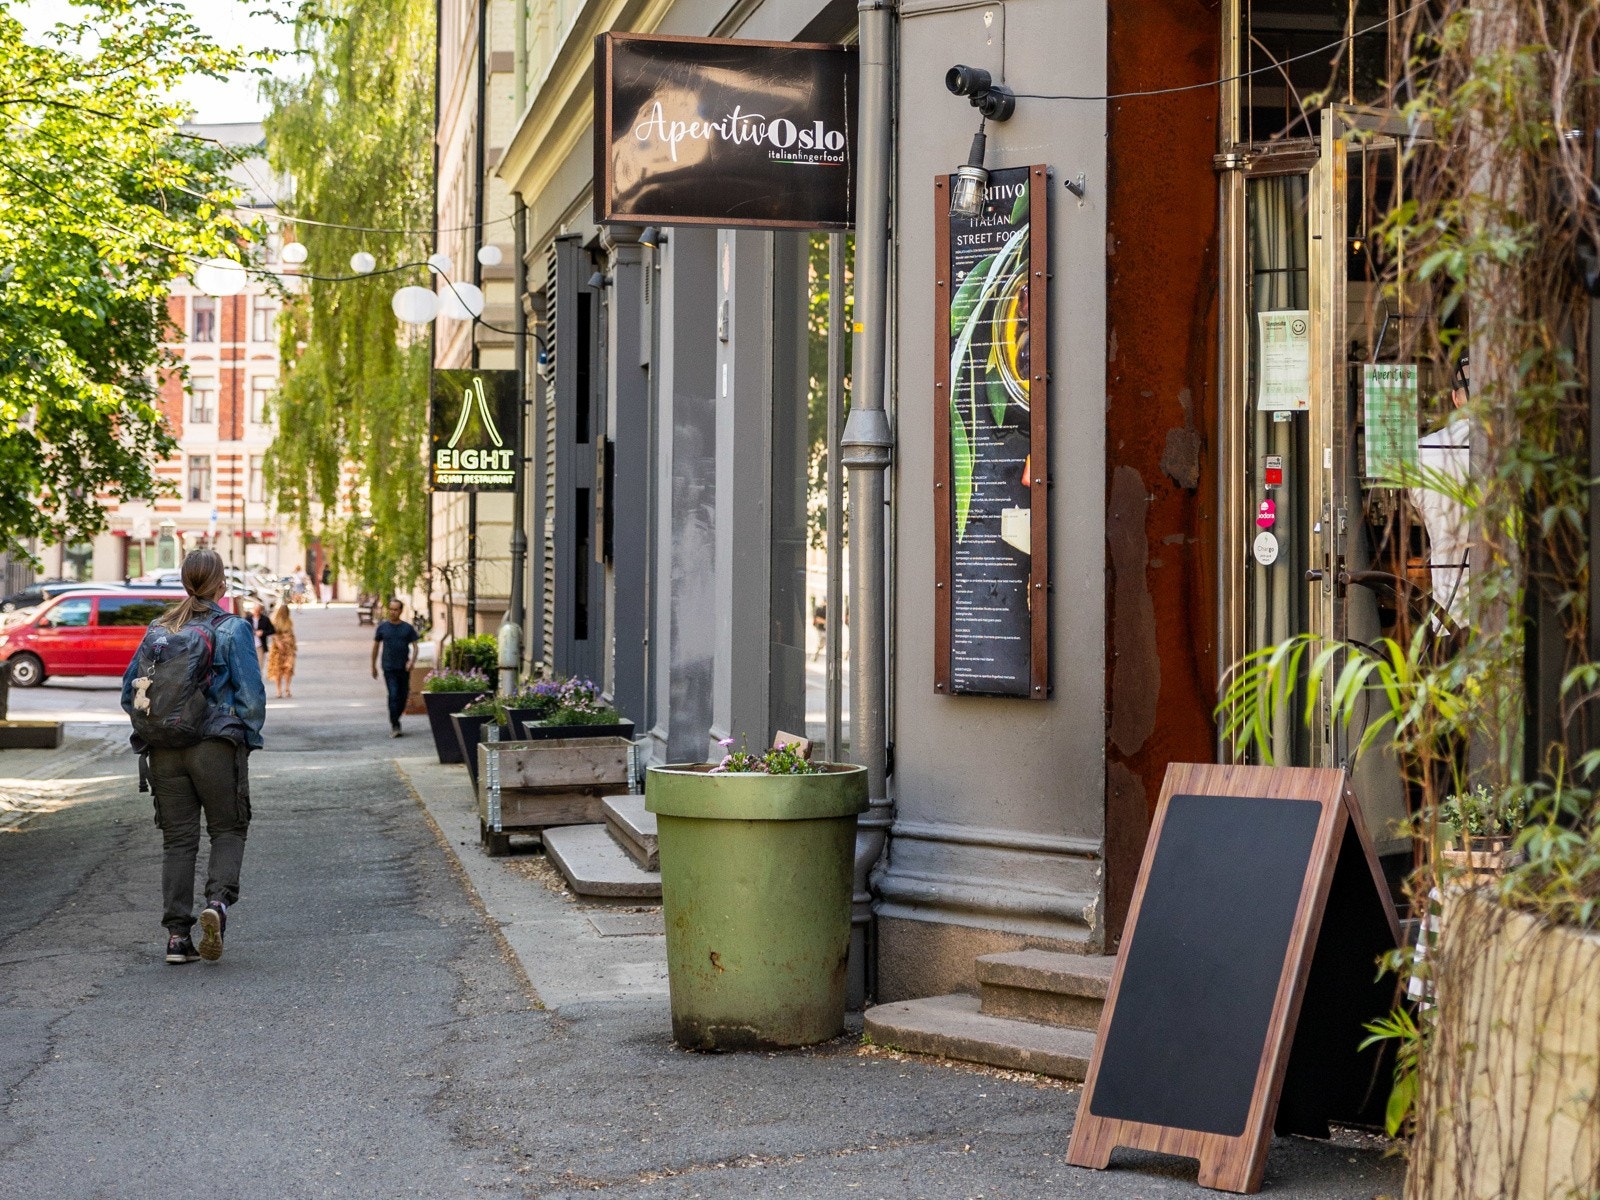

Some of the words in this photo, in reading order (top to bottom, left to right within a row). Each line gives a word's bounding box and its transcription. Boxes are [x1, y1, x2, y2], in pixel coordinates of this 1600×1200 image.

[768, 149, 844, 163] italianfingerfood
[981, 183, 1026, 201] RITIVO
[970, 214, 1012, 228] ITALIAN
[957, 232, 993, 246] STREET
[436, 449, 514, 469] EIGHT
[437, 475, 462, 483] ASIAN
[463, 474, 514, 484] RESTAURANT
